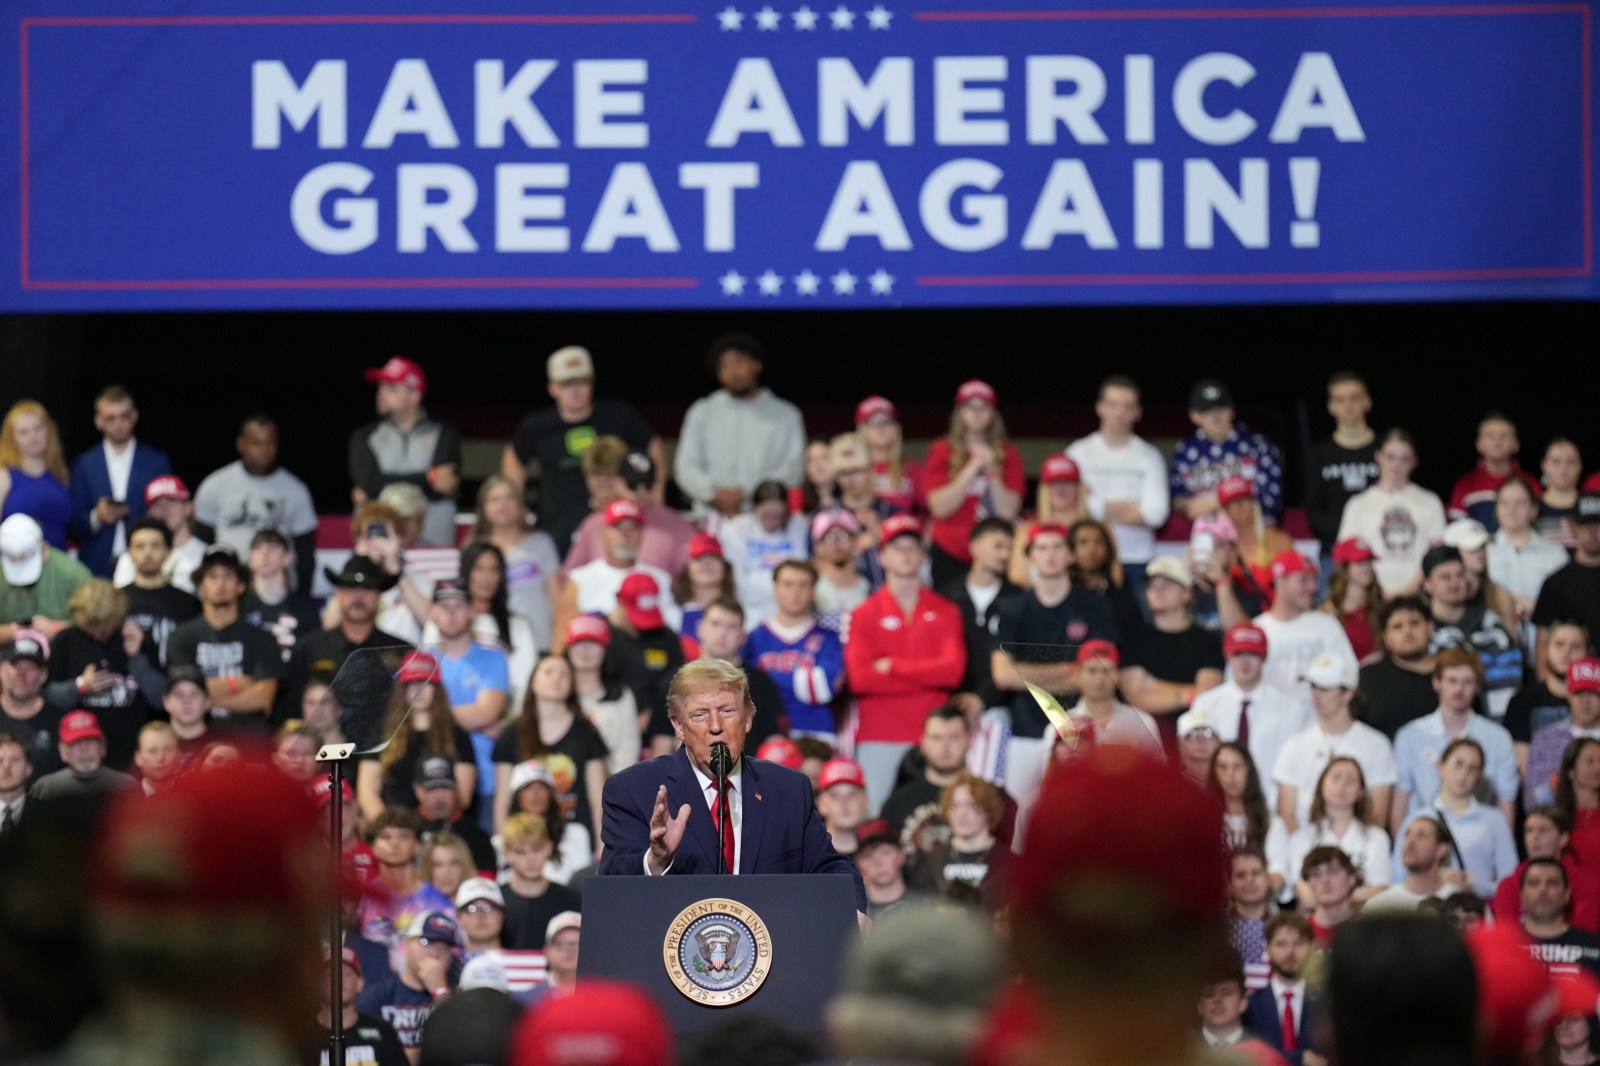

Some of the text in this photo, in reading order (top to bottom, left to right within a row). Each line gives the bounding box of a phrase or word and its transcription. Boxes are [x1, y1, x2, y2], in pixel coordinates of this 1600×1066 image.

[251, 52, 1367, 149] MAKE AMERICA
[290, 157, 1321, 256] GREAT AGAIN!
[668, 902, 769, 1000] SEAL OF THE PRESIDENT OF THE UNITED STATES
